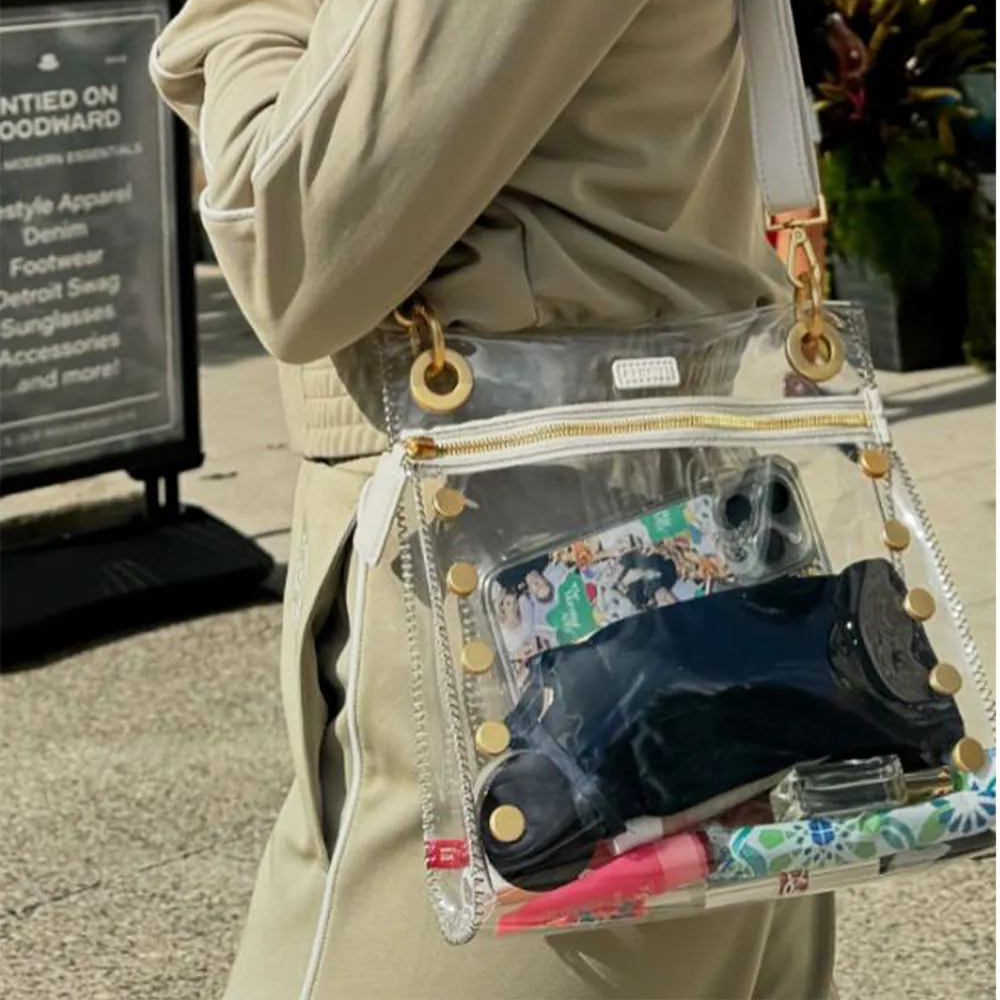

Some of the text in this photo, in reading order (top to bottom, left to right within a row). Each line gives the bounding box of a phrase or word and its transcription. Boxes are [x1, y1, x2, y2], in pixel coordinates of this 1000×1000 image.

[83, 83, 118, 107] ON
[23, 221, 88, 246] Denim
[9, 248, 104, 278] Footwear
[67, 275, 120, 297] Swag
